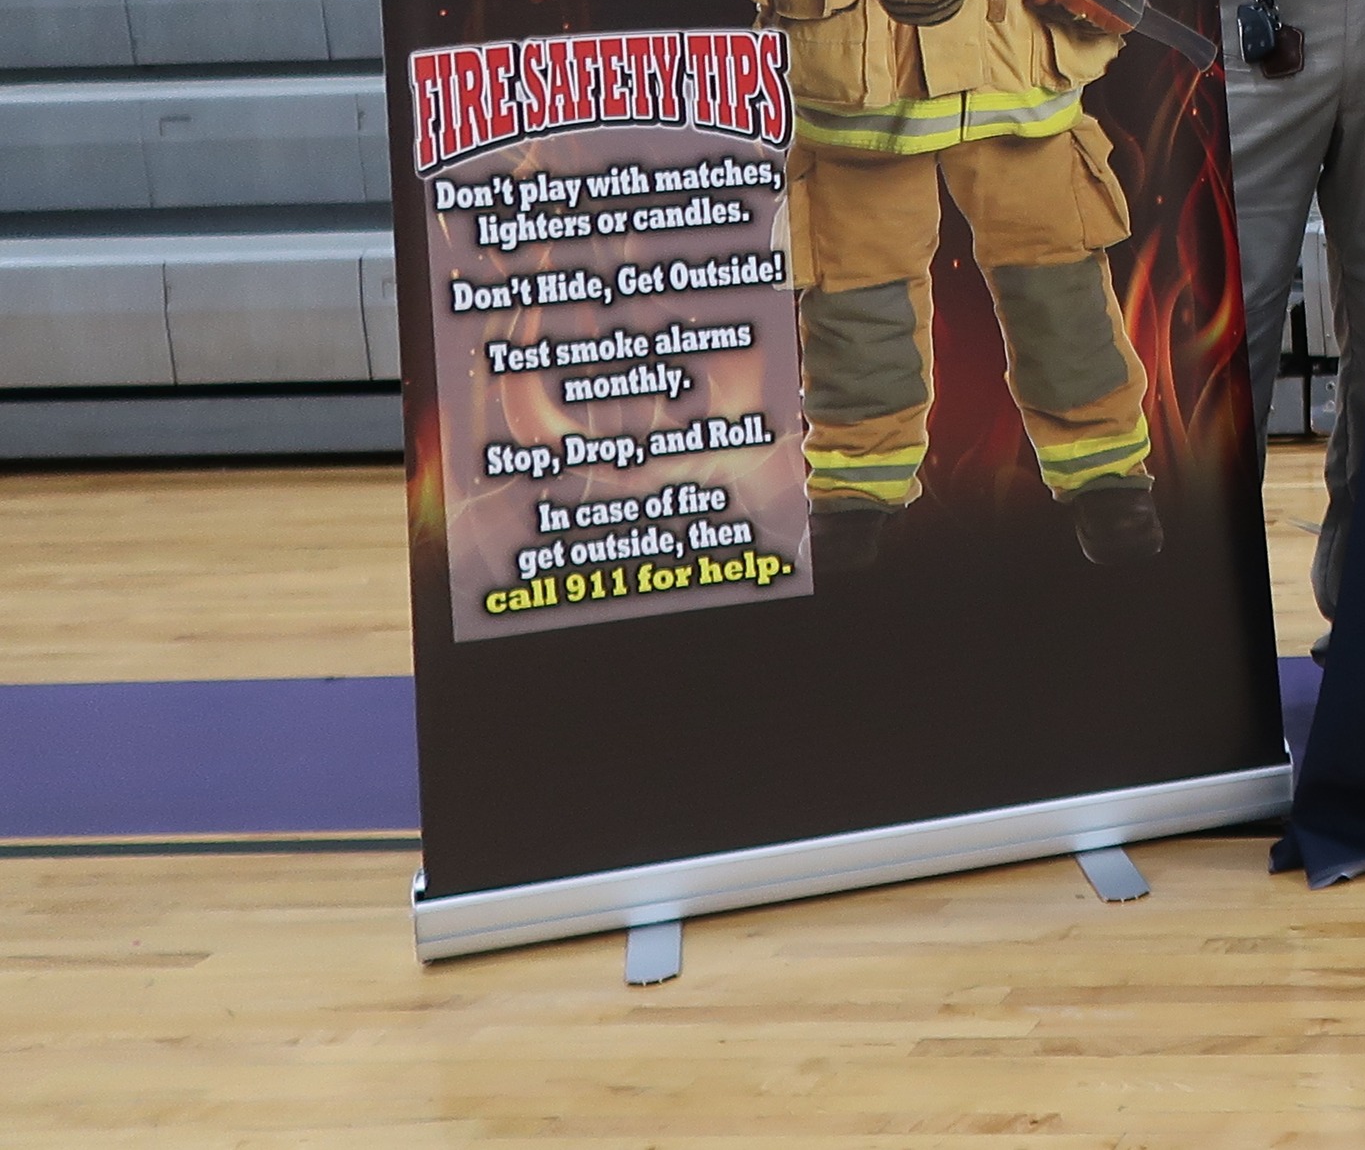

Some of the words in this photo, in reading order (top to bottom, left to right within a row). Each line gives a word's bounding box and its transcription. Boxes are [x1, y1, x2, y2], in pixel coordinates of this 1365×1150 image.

[413, 42, 520, 169] FIRE
[520, 32, 682, 130] SAFETY
[684, 28, 788, 144] TIPS
[436, 180, 514, 211] Don't
[520, 175, 581, 212] play
[588, 165, 650, 199] with
[655, 157, 782, 194] matches,
[478, 211, 592, 251] lighters
[597, 213, 629, 234] or
[632, 197, 749, 233] candles.
[452, 277, 532, 312] Don't
[536, 273, 613, 306] Hide,
[617, 262, 665, 297] Get
[669, 251, 784, 292] Outside!
[489, 339, 551, 372] Test
[556, 330, 649, 366] smoke
[655, 324, 752, 355] alarms
[564, 364, 691, 402] monthly.
[486, 445, 561, 478] Stop,
[566, 433, 645, 467] Drop,
[650, 424, 702, 454] and
[707, 416, 772, 448] Roll.
[539, 501, 571, 532] In
[575, 502, 640, 528] case
[645, 492, 672, 518] of
[677, 485, 726, 513] fire
[518, 546, 566, 581] get
[571, 527, 684, 566] outside,
[688, 520, 752, 551] then
[485, 577, 558, 614] call
[565, 568, 628, 600] 911
[638, 561, 692, 592] for
[699, 550, 792, 586] help.
